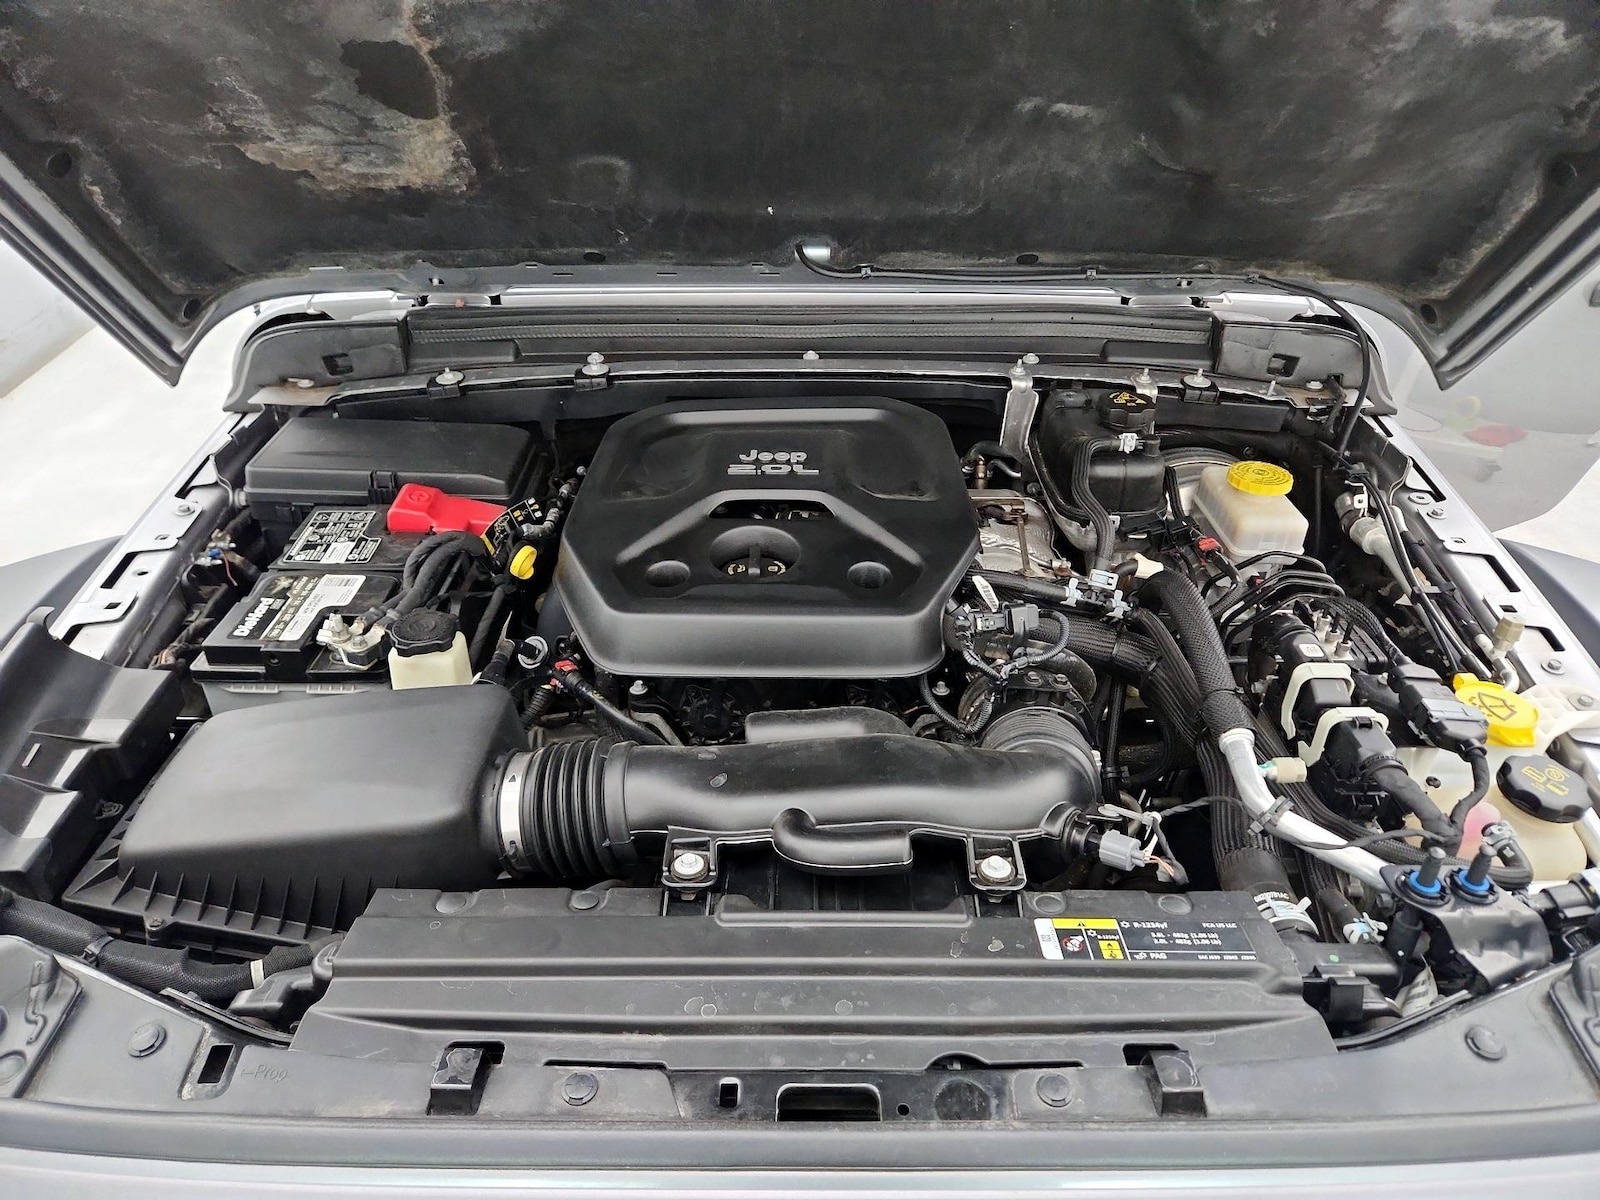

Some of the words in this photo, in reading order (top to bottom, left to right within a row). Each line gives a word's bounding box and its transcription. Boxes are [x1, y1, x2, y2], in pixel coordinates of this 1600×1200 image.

[739, 449, 808, 463] Jeep
[727, 464, 820, 475] 2.0L
[232, 597, 275, 637] DieHard
[1133, 921, 1168, 929] R-1234yf
